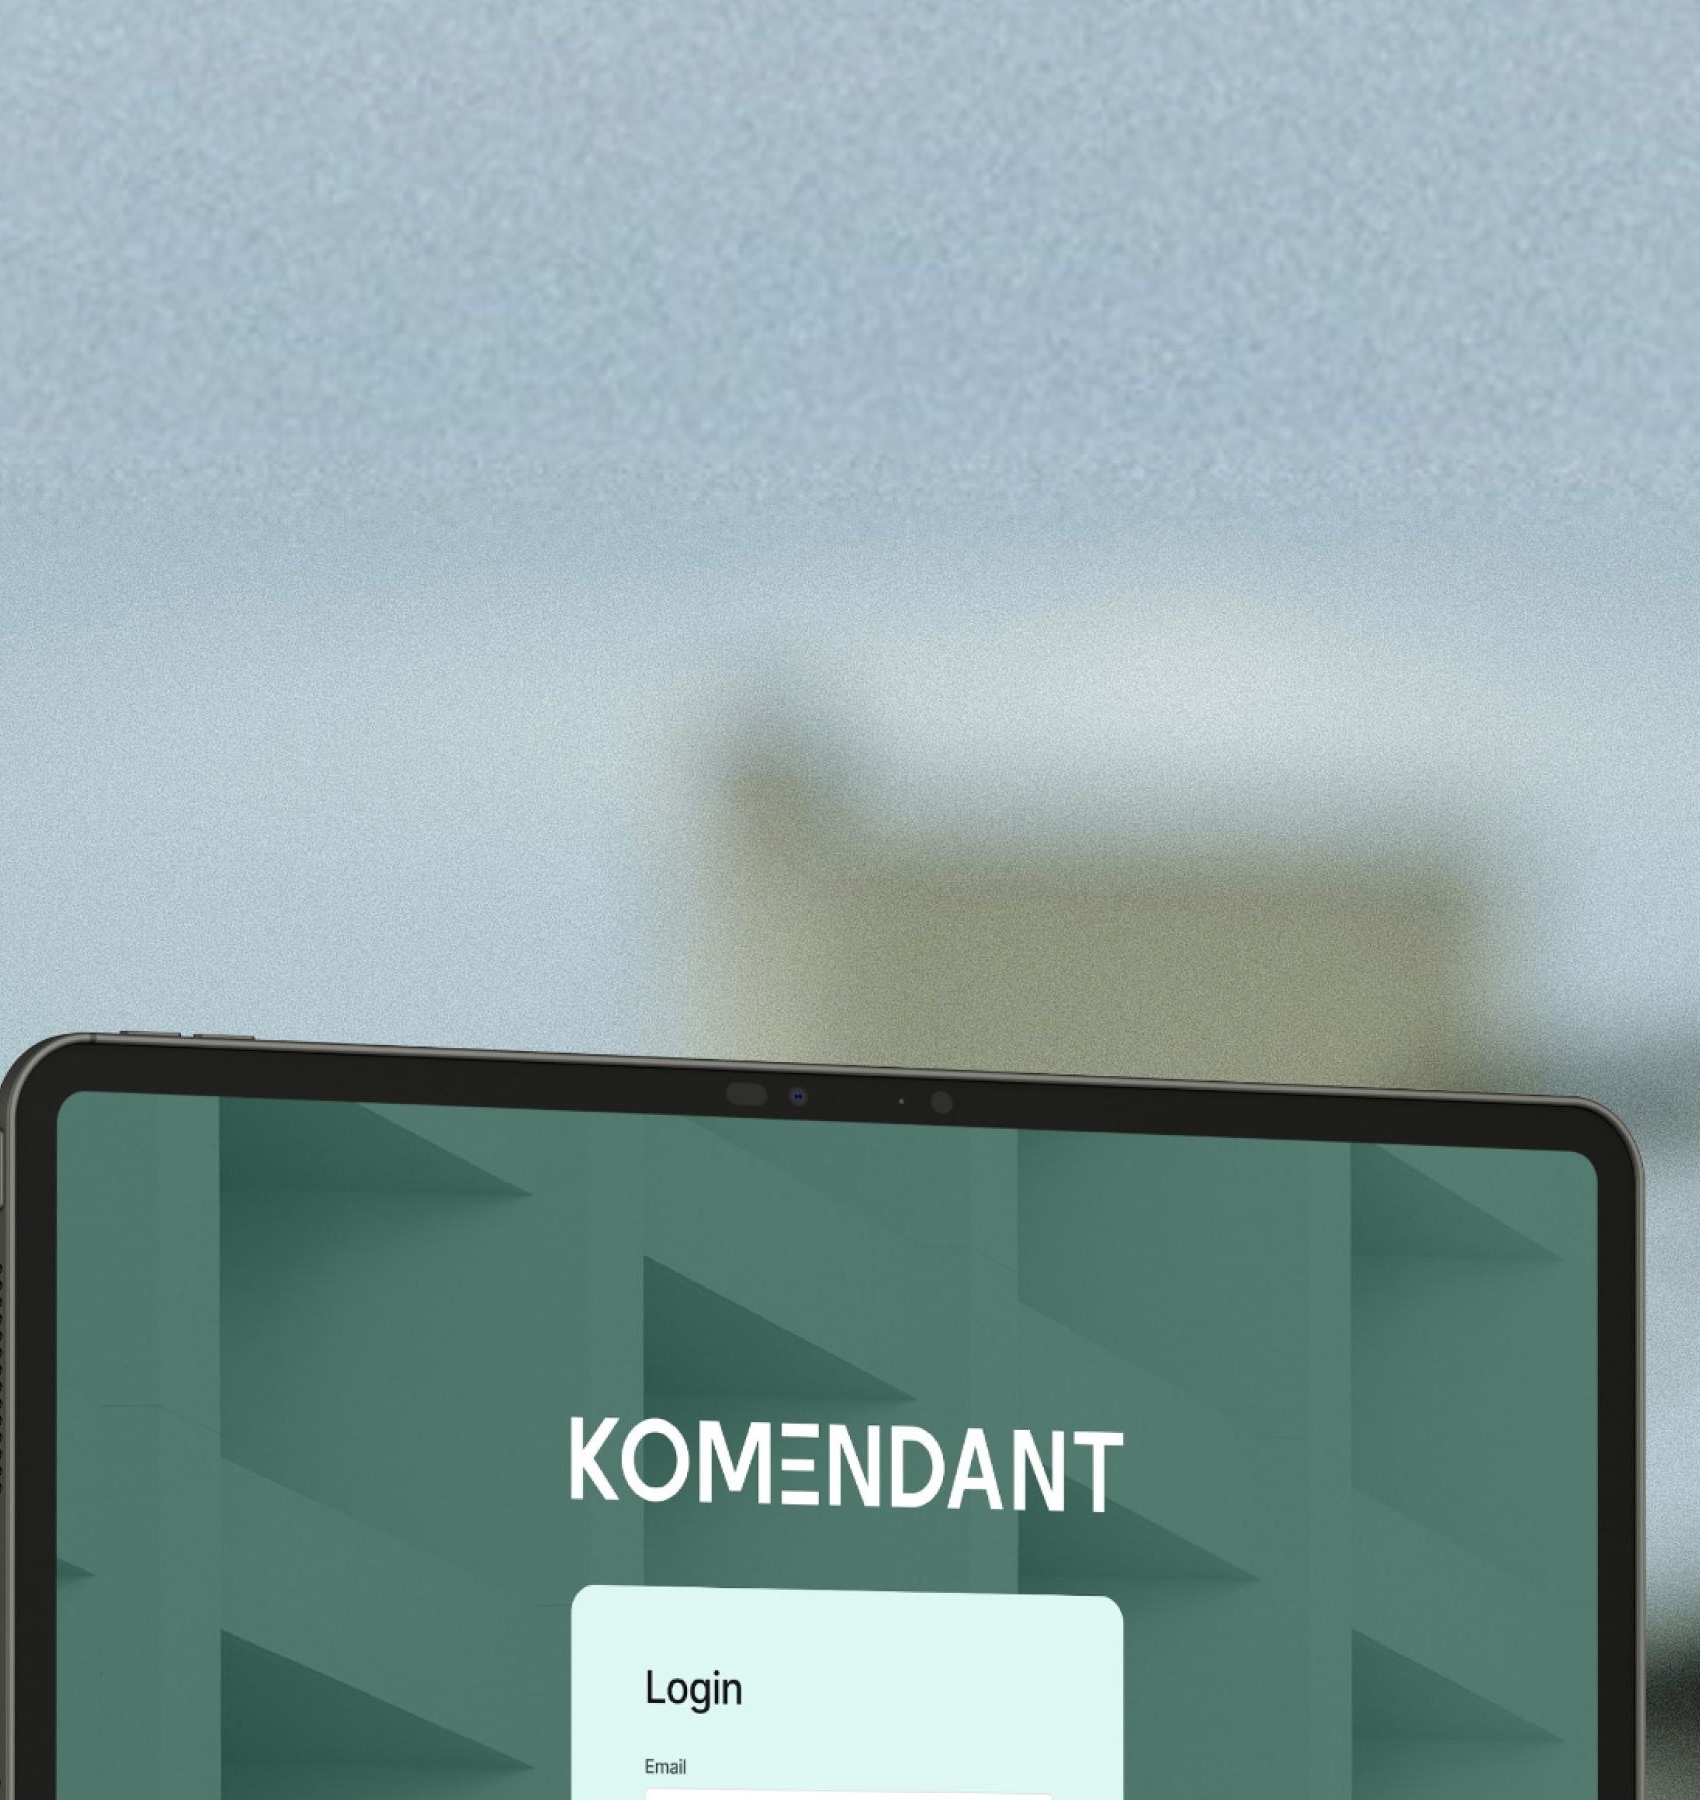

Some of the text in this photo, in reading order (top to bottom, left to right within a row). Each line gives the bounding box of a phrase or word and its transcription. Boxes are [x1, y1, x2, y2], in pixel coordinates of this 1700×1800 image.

[570, 1416, 1125, 1513] KOMENDANT
[646, 1669, 743, 1715] Login
[644, 1758, 687, 1775] Email
